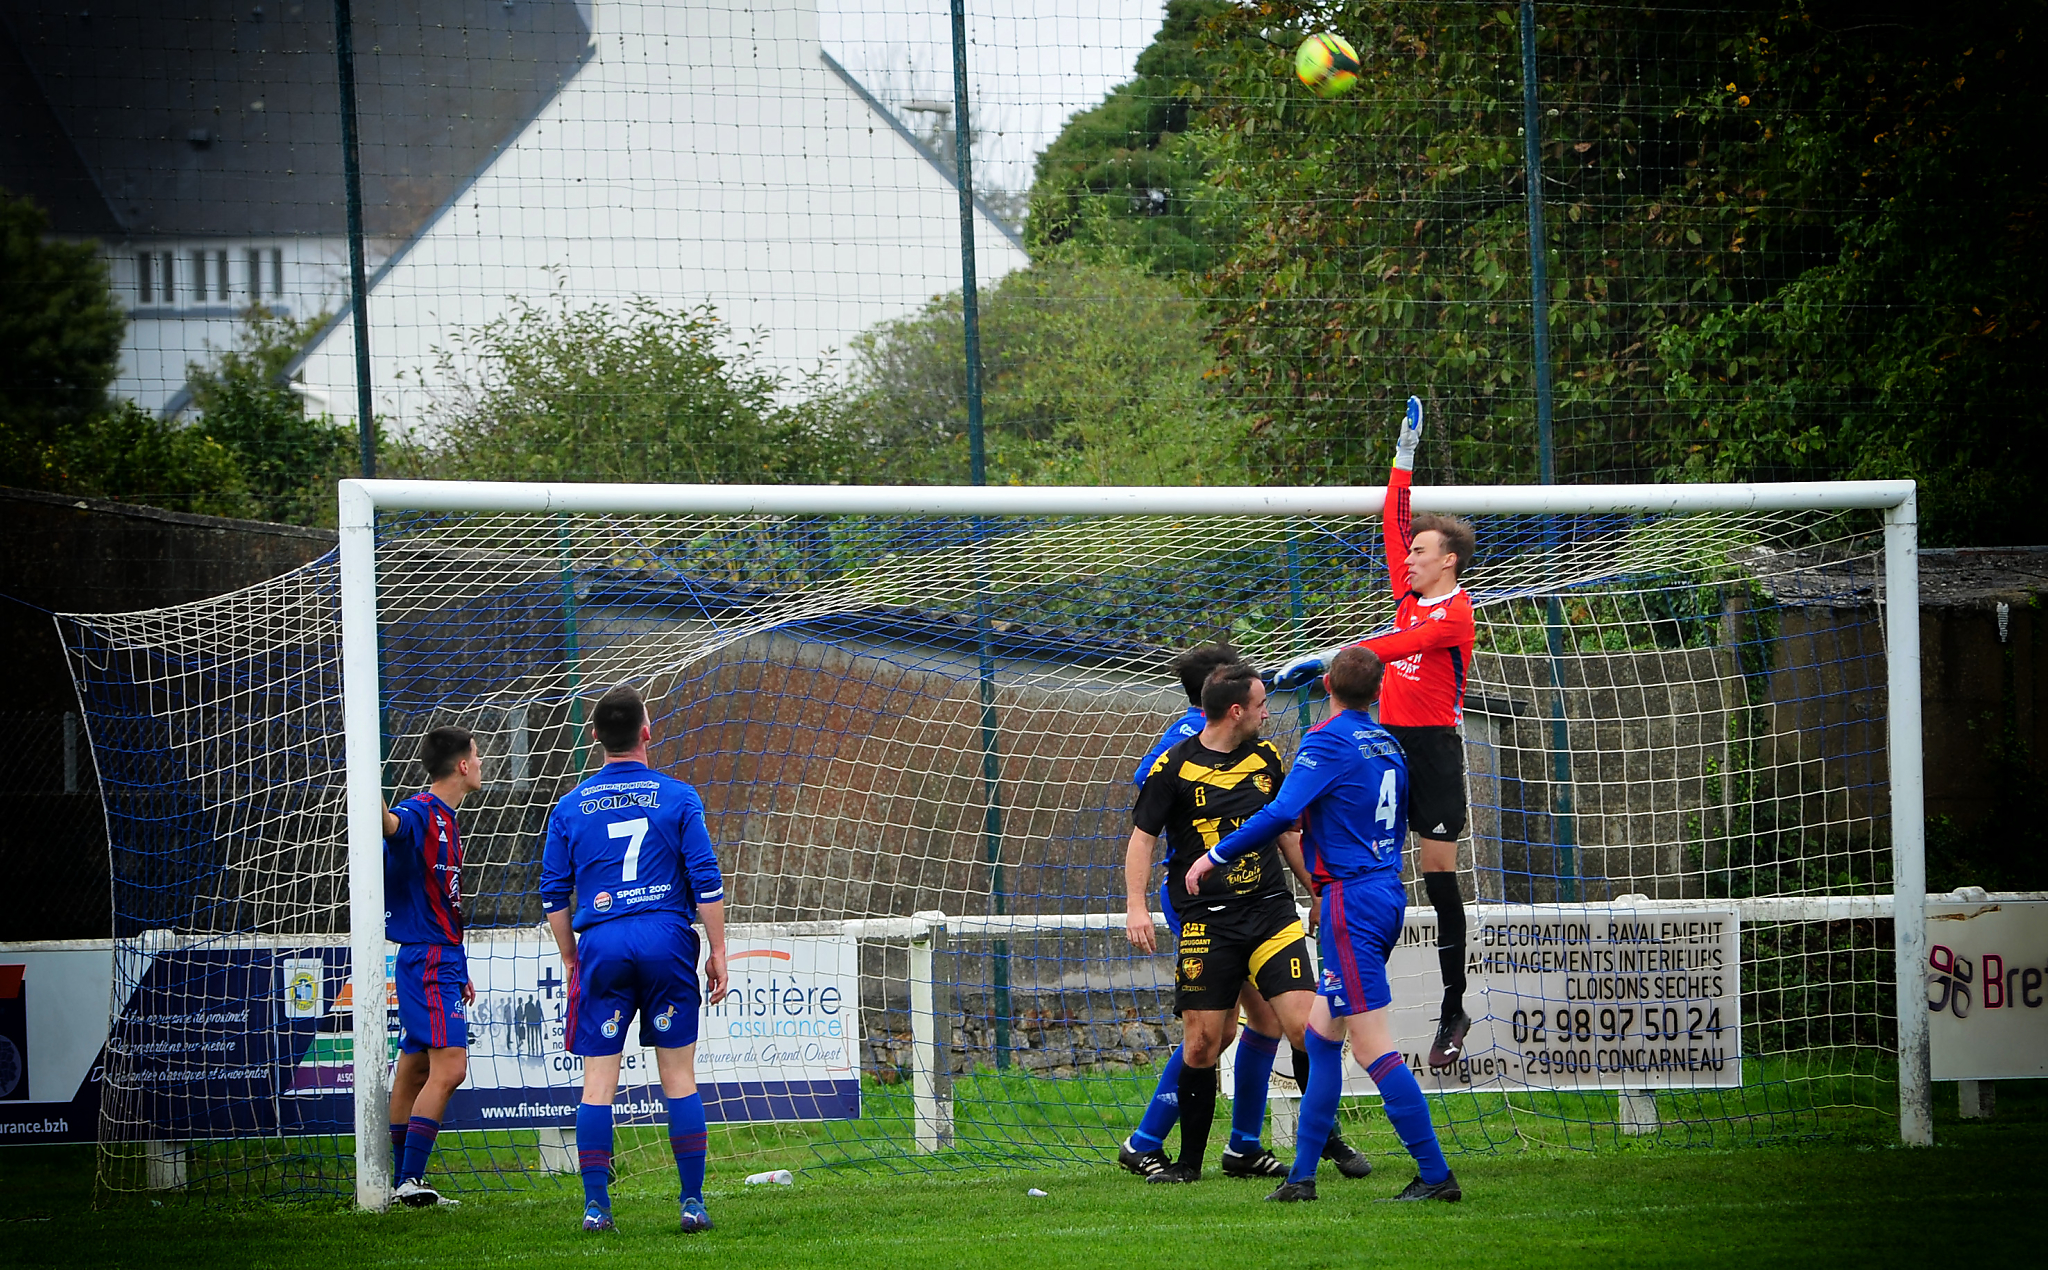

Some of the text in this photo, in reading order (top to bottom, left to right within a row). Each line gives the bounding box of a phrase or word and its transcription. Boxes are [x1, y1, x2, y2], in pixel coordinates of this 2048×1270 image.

[1375, 769, 1397, 830] 4
[607, 817, 649, 882] 7
[617, 884, 671, 898] SPORT 2000
[1484, 924, 1589, 945] DECORATION
[1608, 923, 1723, 944] RAVALEMENT
[1290, 957, 1301, 978] 8
[1467, 949, 1723, 973] AMENAGEMENTS INTERIEURS
[1566, 976, 1723, 1000] CLOISONS SECHES
[729, 1018, 842, 1038] assurance
[1513, 1007, 1723, 1044] 02 98 97 50 24
[762, 1043, 802, 1066] Grand
[804, 1042, 842, 1062] Ouest
[1526, 1050, 1591, 1074] 29900
[1598, 1048, 1724, 1073] CONCARNEAU
[0, 1118, 68, 1134] rance.bzh
